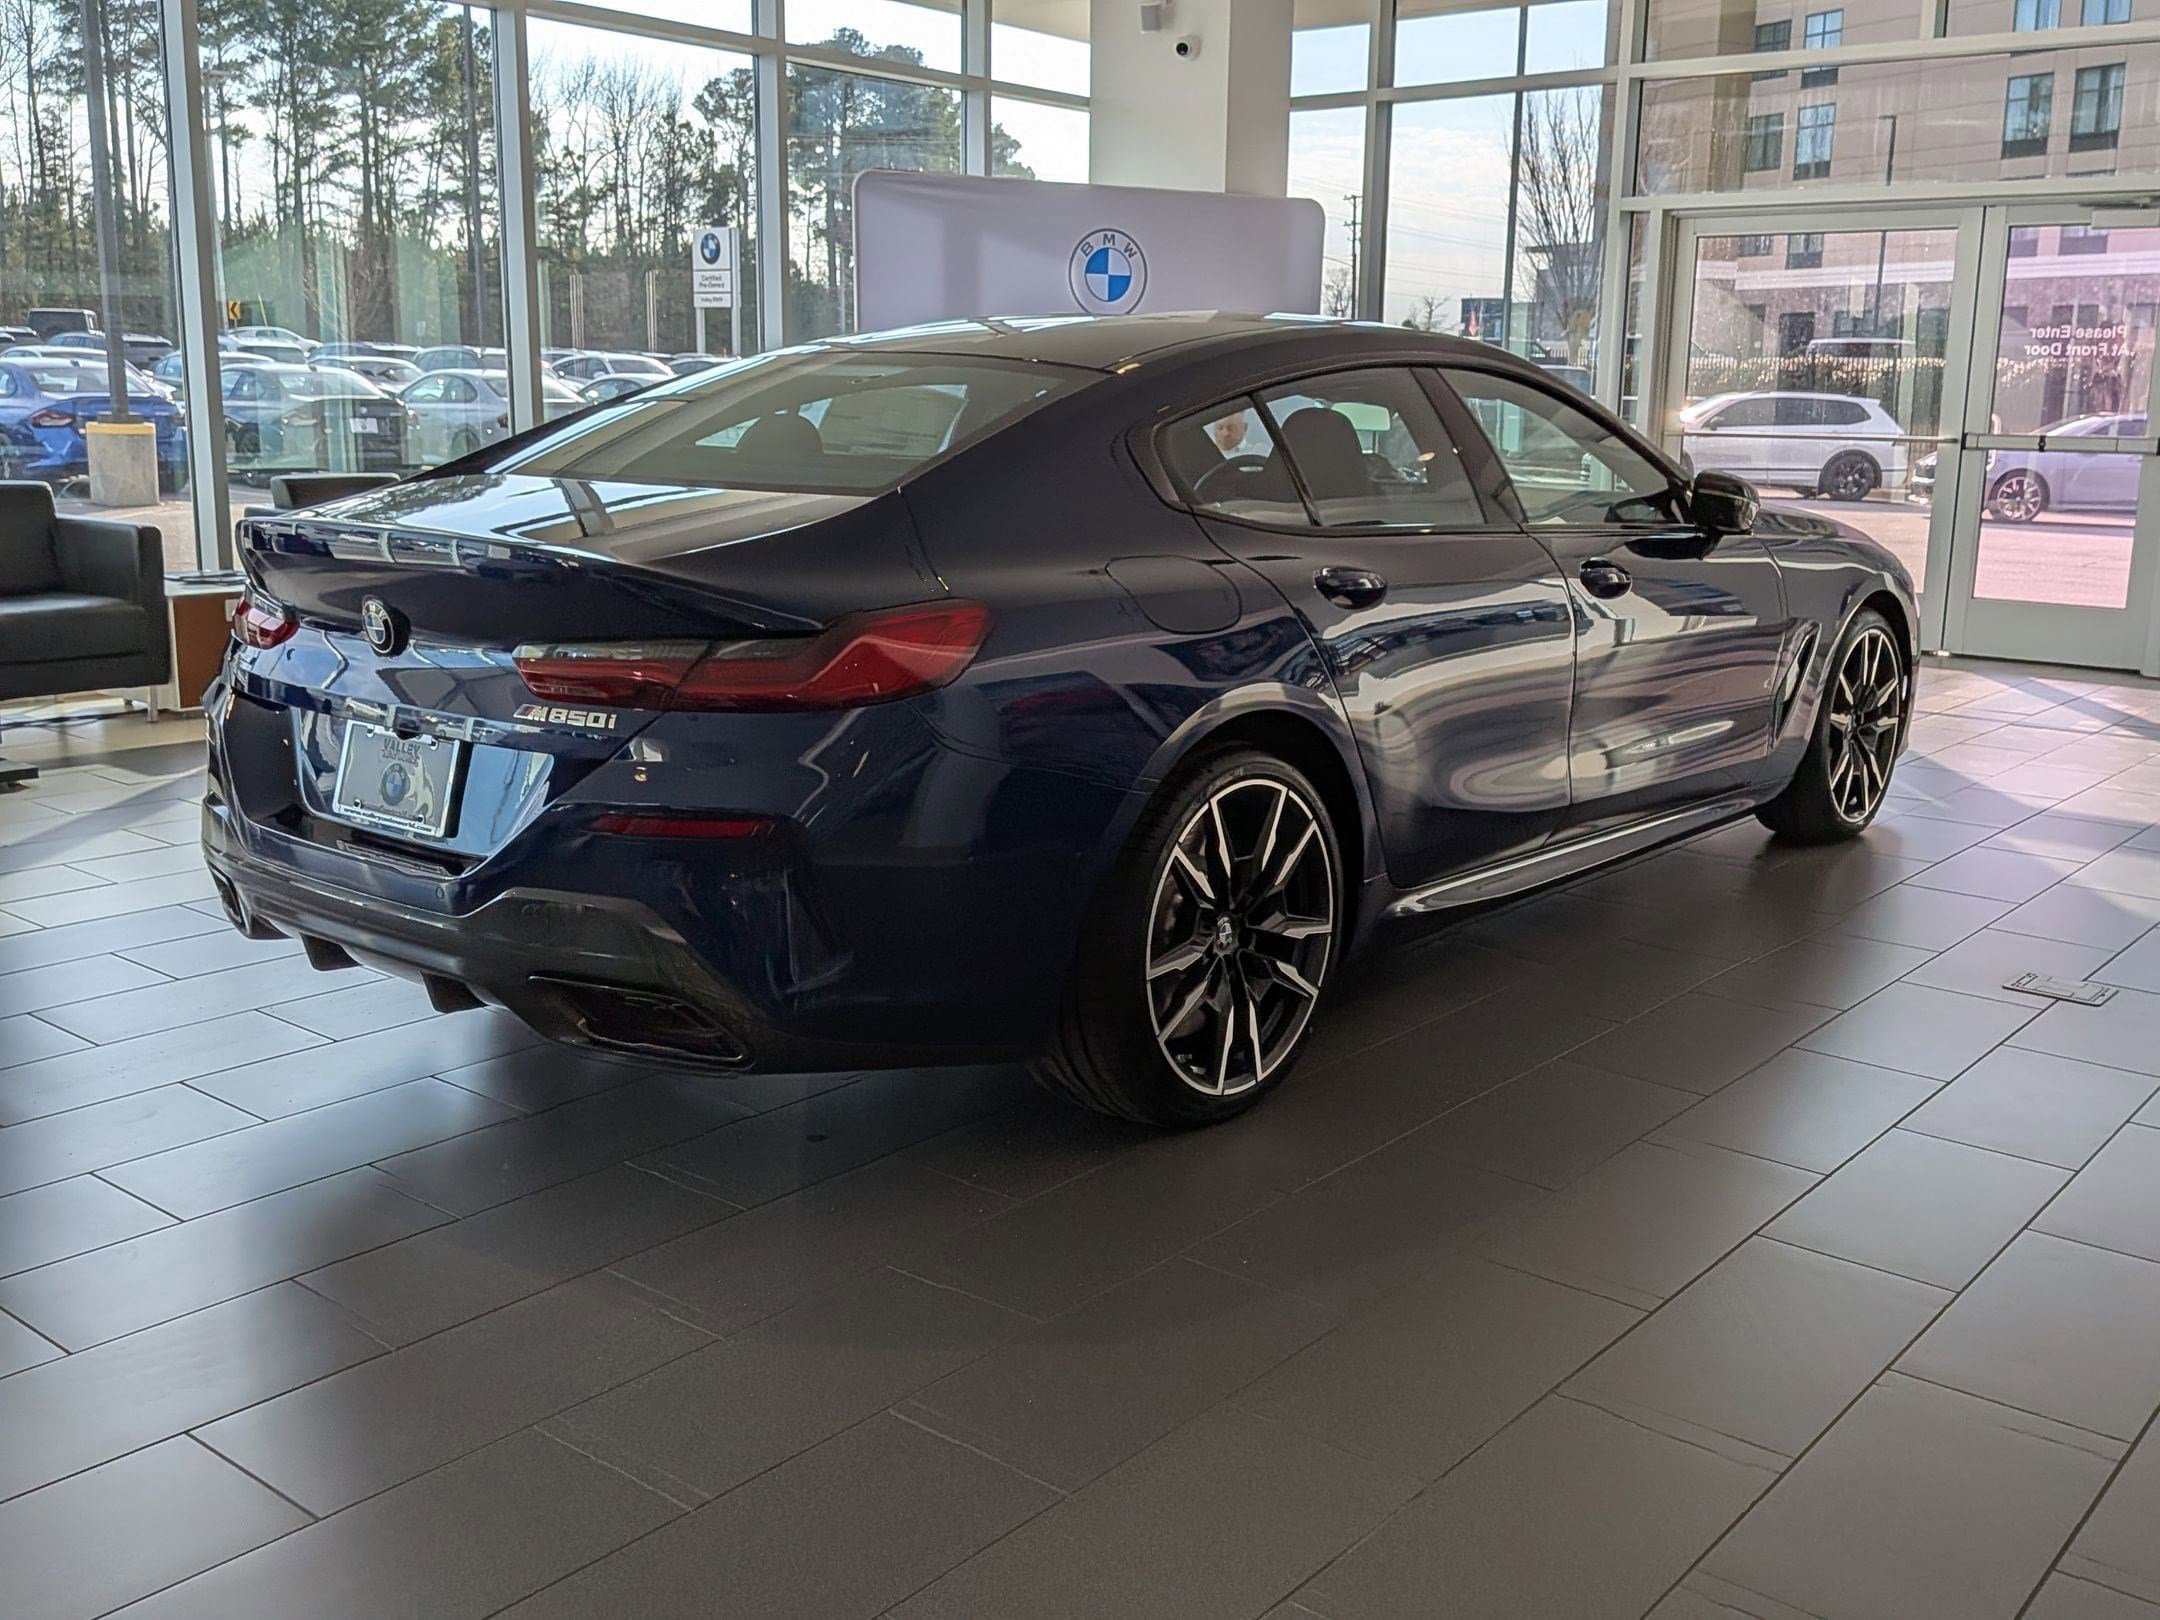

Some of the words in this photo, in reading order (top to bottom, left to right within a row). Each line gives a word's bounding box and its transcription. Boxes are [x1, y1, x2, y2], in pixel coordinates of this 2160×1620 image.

[1080, 233, 1138, 259] BMW
[522, 705, 617, 730] M850i
[384, 737, 421, 760] VALLEY
